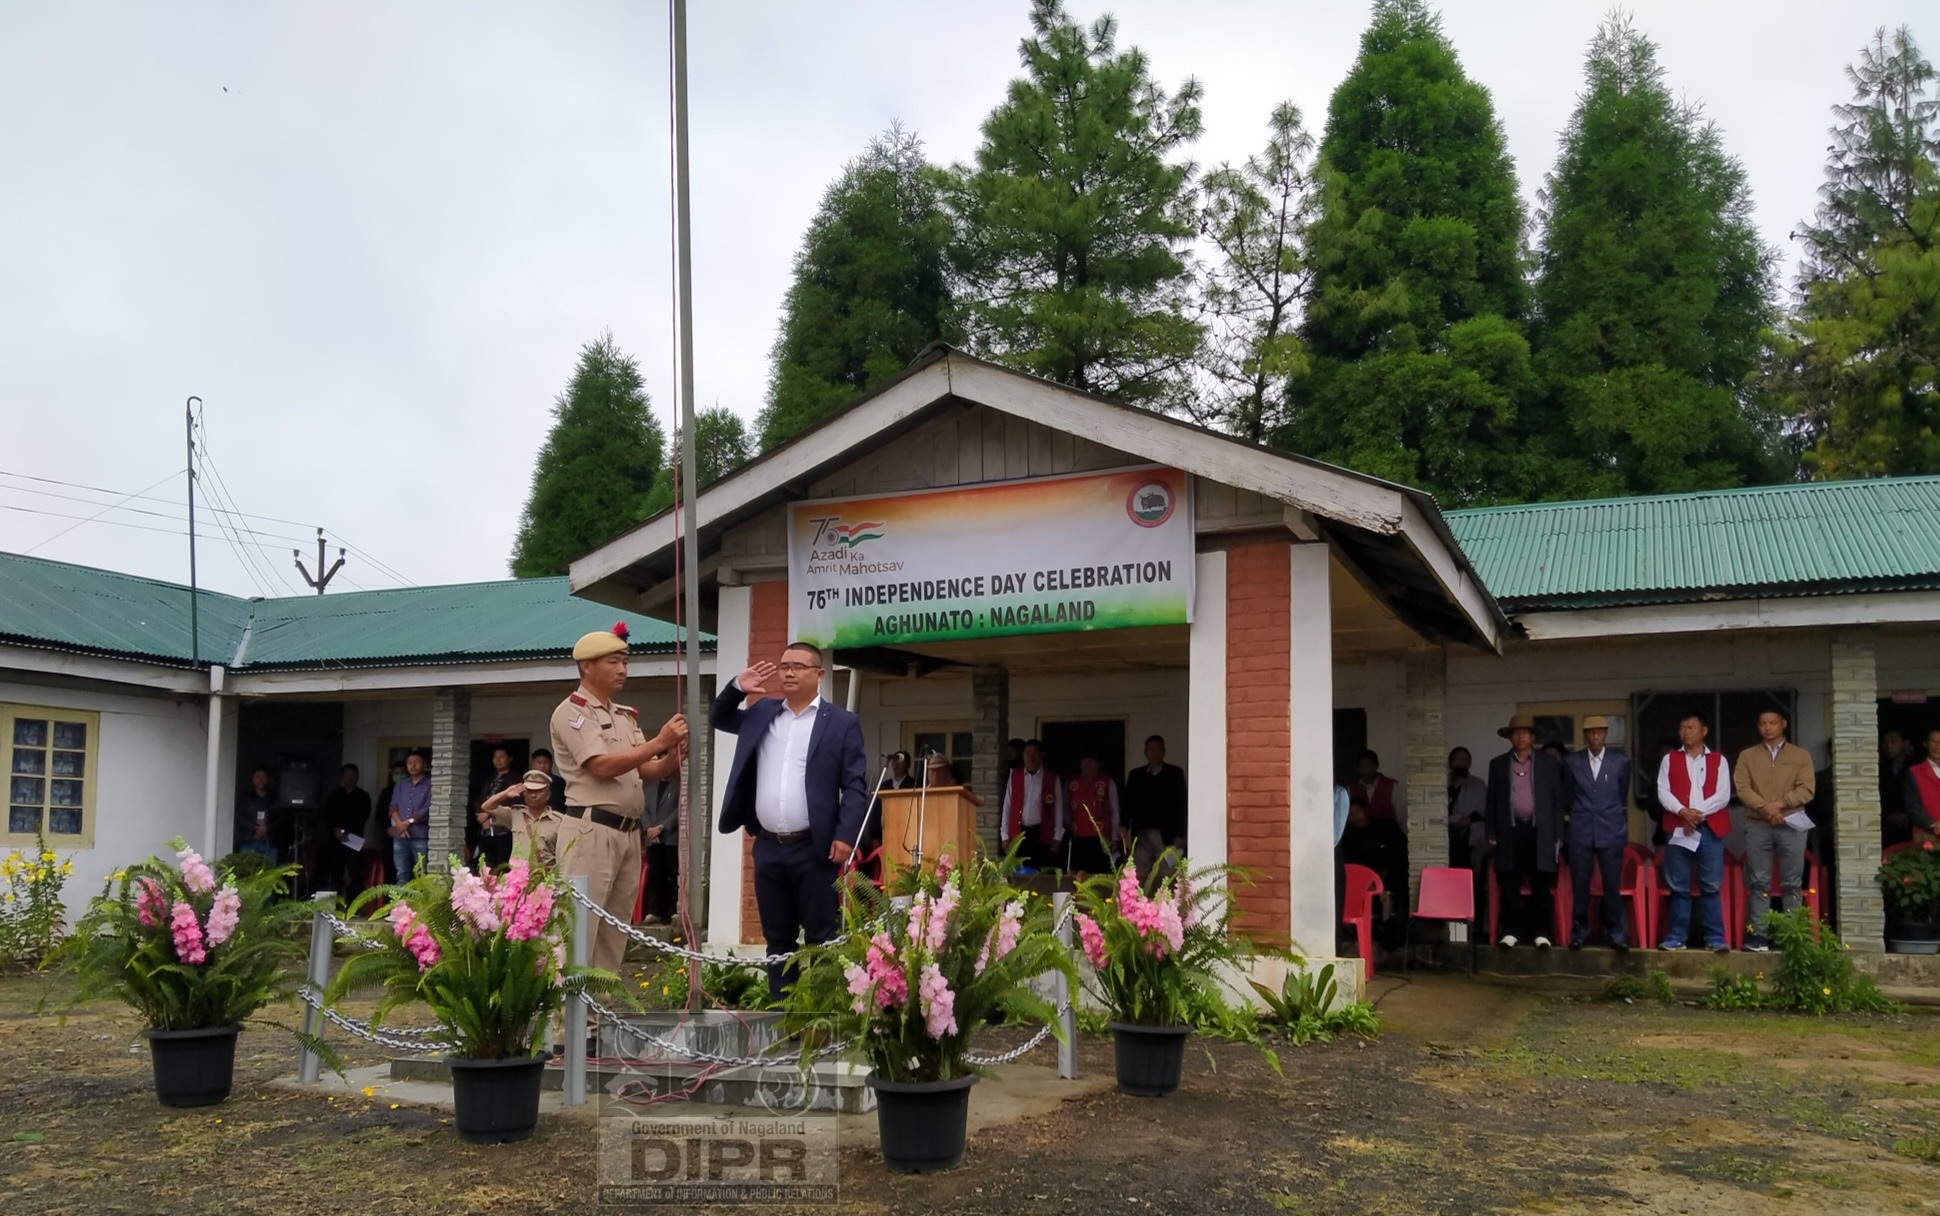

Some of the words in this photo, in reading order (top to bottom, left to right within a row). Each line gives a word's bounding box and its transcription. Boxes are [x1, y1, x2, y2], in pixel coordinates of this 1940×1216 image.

[810, 547, 848, 562] Azadi
[850, 551, 865, 562] Ka
[806, 562, 837, 575] Amrit
[839, 561, 905, 576] Mahotsav
[807, 588, 840, 610] 76TH
[845, 576, 985, 607] INDEPENDENCE
[991, 573, 1027, 595] DAY
[1033, 560, 1172, 592] CELEBRATION
[874, 609, 973, 636] AGHUNATO
[979, 613, 984, 629] :
[990, 600, 1096, 627] NAGALAND
